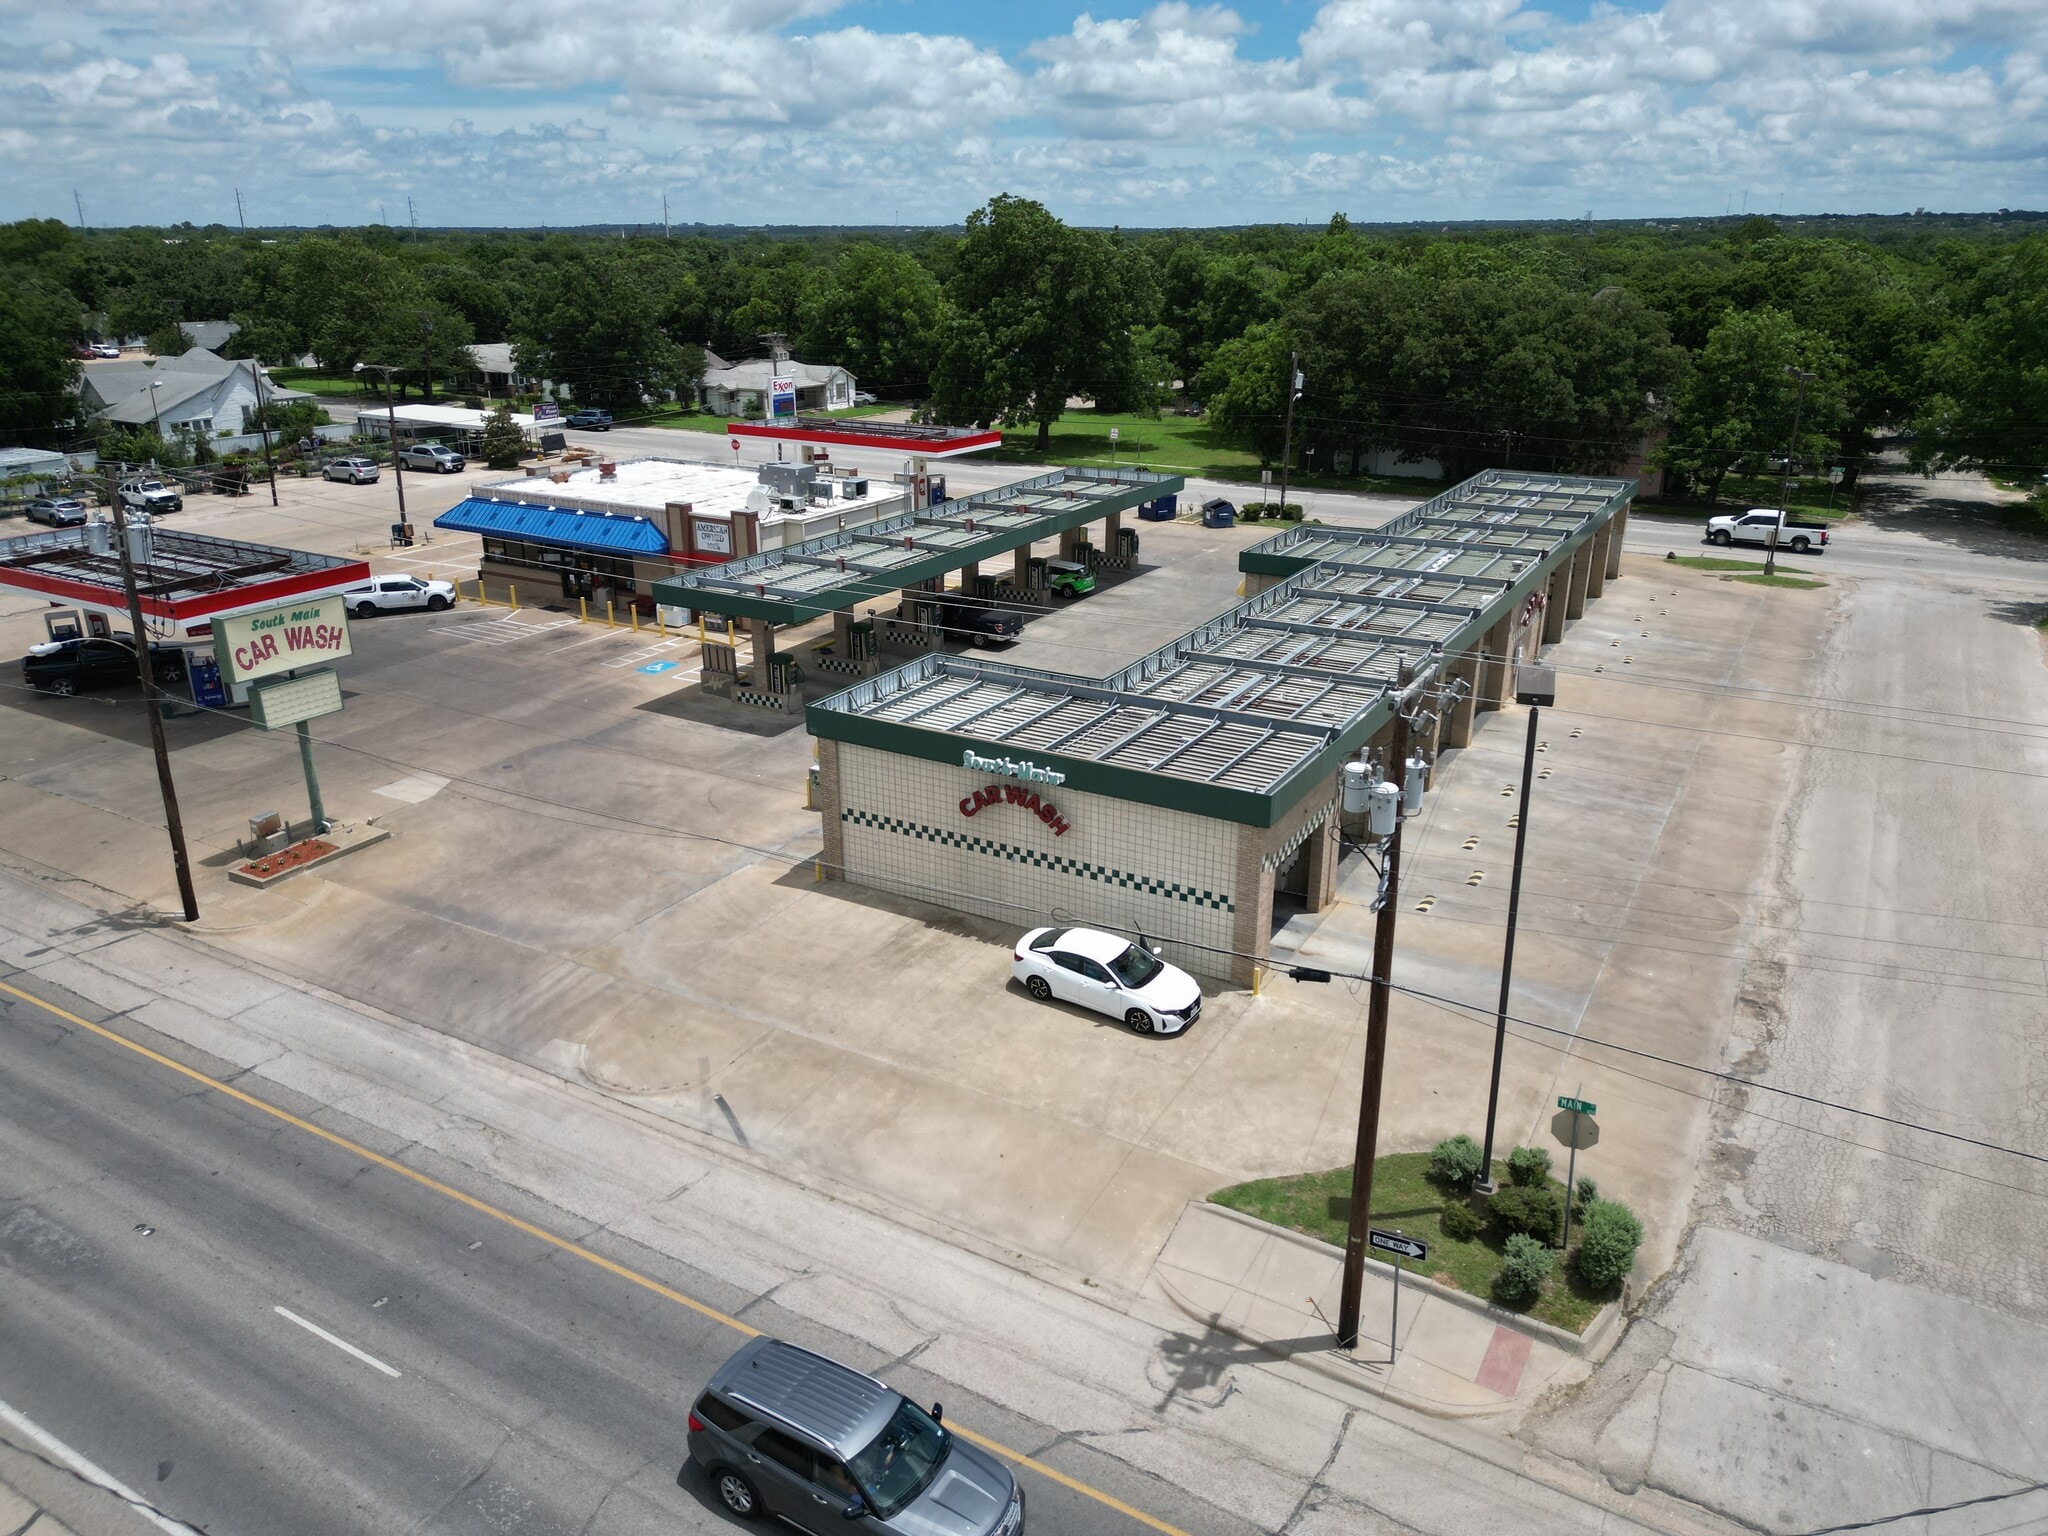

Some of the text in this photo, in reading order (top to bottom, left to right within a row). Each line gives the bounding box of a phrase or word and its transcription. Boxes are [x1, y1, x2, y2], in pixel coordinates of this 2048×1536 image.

[773, 381, 793, 392] Exxon
[696, 523, 728, 534] AMERICAN
[251, 607, 321, 632] South Main
[235, 624, 343, 671] CAR WASH
[962, 749, 1066, 786] South Main
[959, 783, 1072, 838] CAR WASH
[1560, 1098, 1583, 1111] MAIN
[1374, 1236, 1409, 1251] ONE WAY
